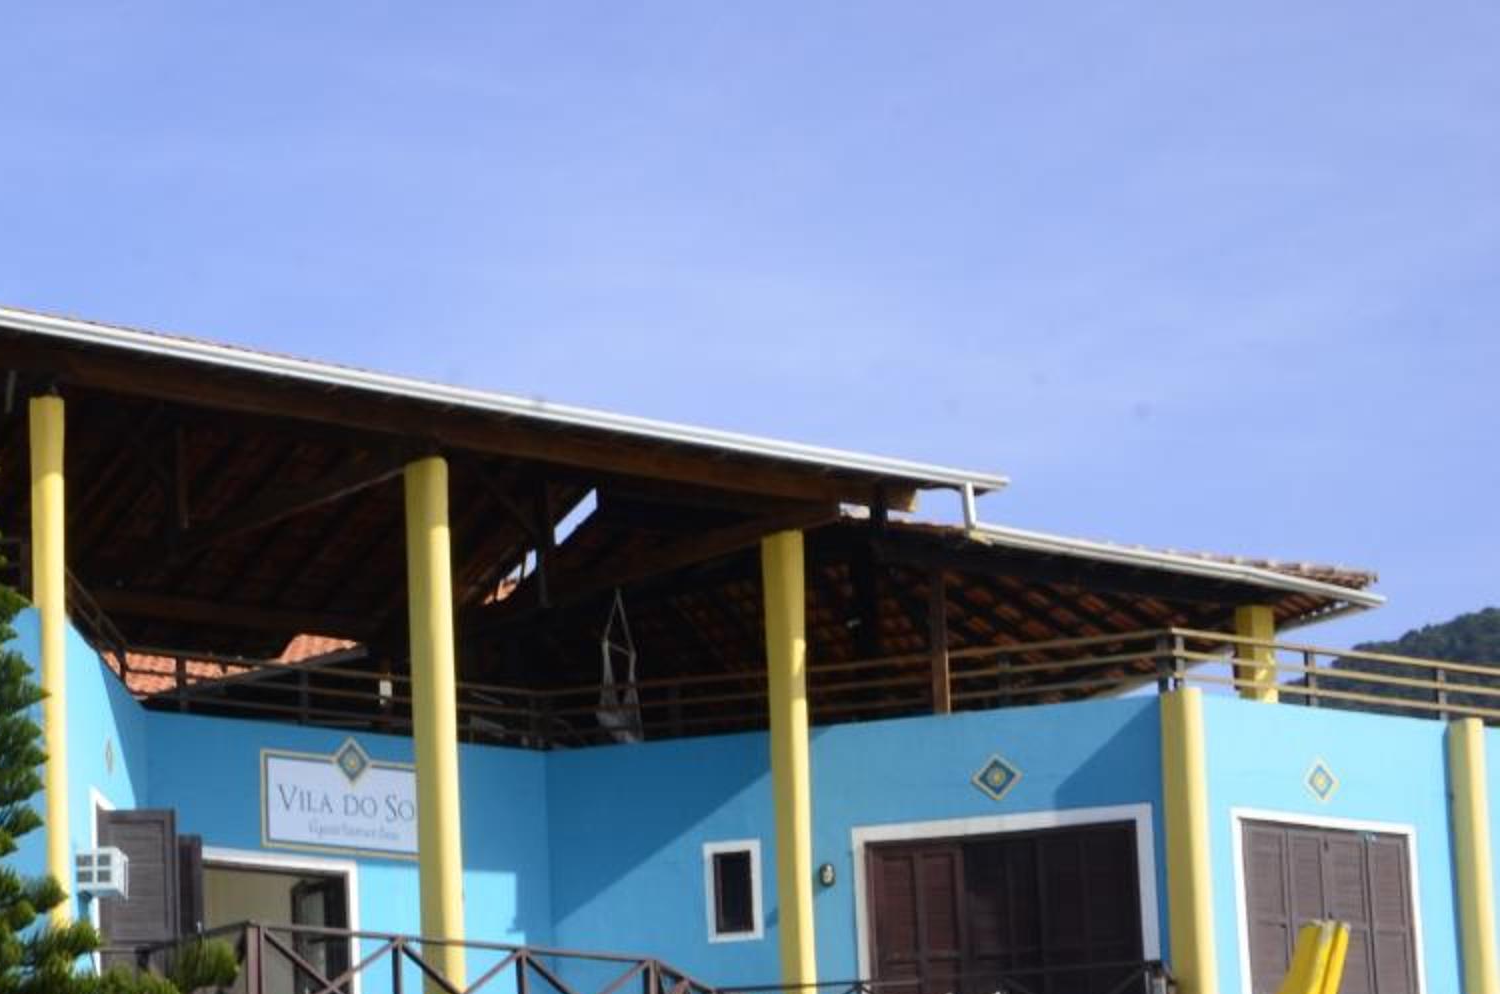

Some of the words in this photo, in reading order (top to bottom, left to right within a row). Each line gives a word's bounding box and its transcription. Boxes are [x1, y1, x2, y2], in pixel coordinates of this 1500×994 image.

[277, 783, 333, 814] VILA
[342, 793, 378, 818] DO
[385, 793, 415, 823] SO
